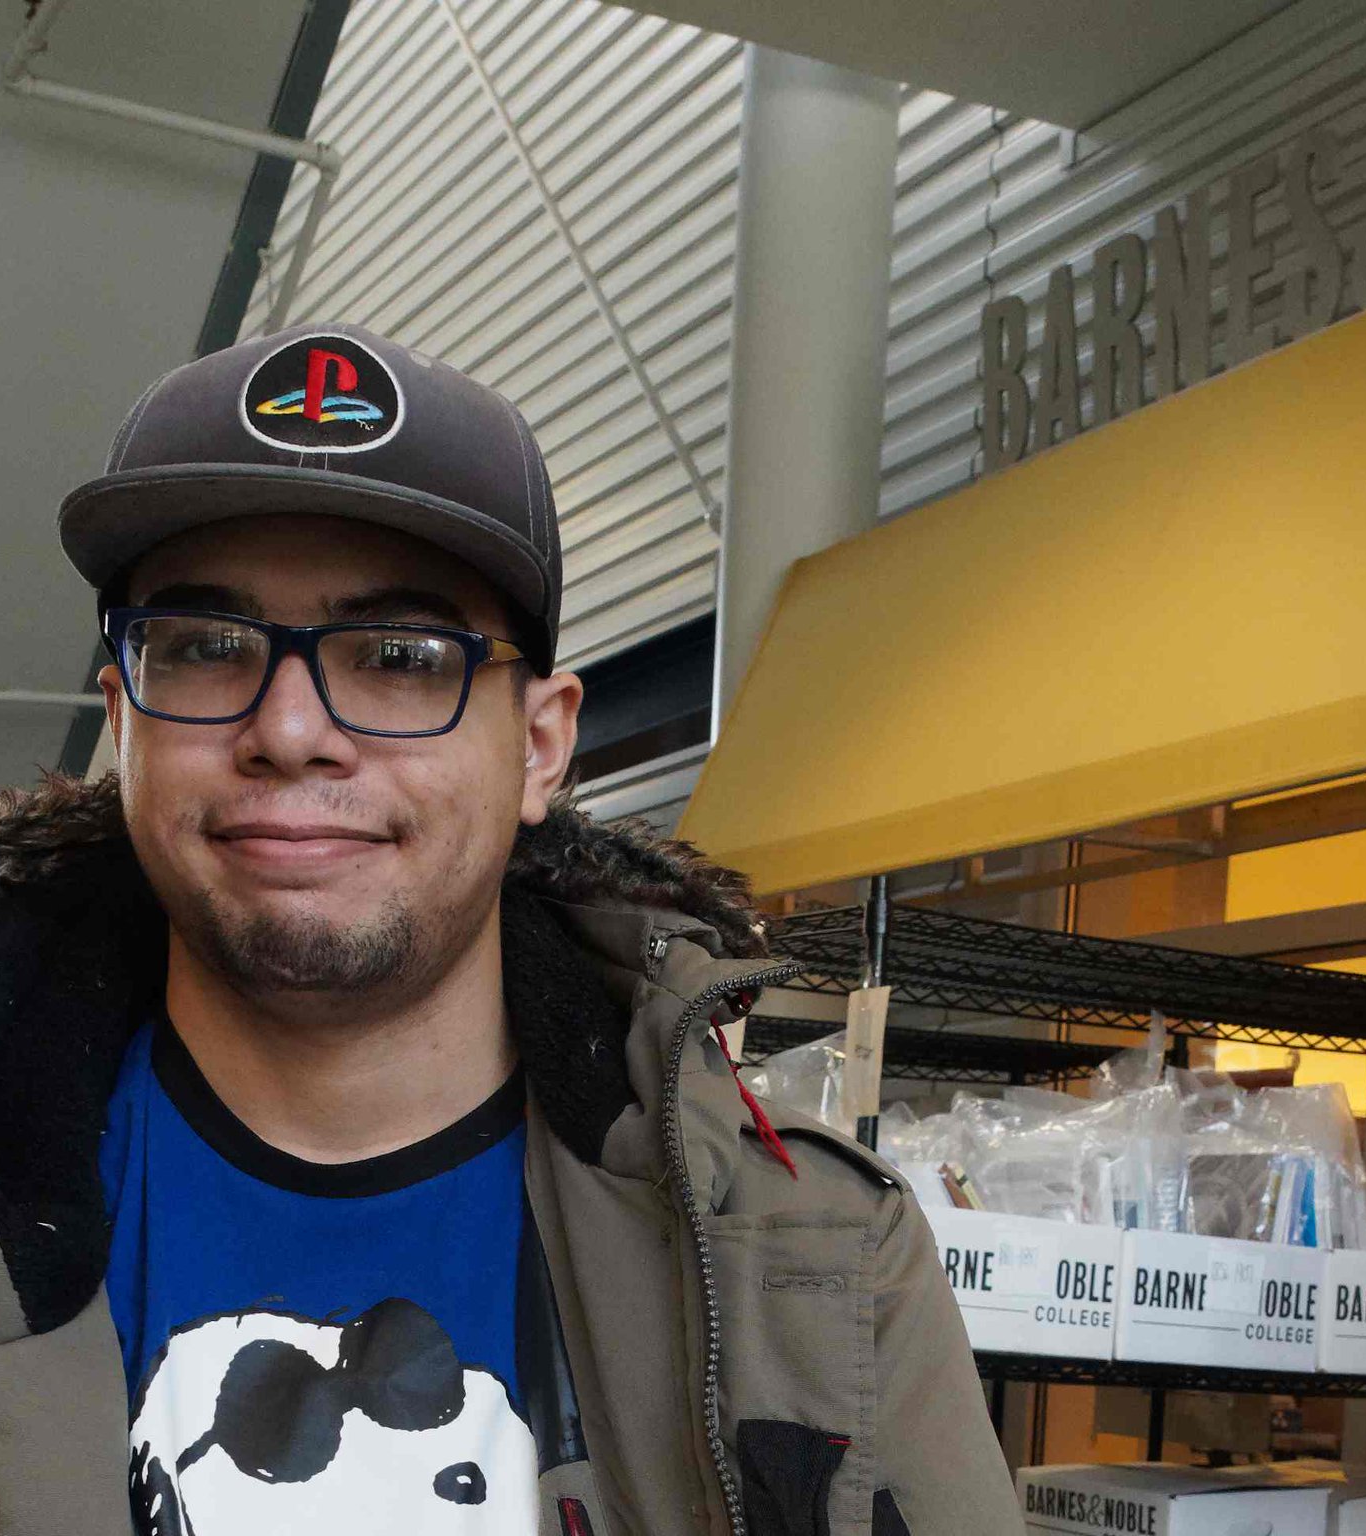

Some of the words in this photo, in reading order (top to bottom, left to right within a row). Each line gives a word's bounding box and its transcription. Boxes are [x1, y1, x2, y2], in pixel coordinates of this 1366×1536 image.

[982, 128, 1345, 474] BARNES
[1056, 1259, 1114, 1303] OBLE
[1133, 1267, 1207, 1311] BARNE
[1262, 1279, 1317, 1321] OBLE
[1034, 1305, 1111, 1328] COLLEGE
[1245, 1323, 1314, 1344] COLLEGE
[1026, 1483, 1085, 1523] BARNES
[1104, 1498, 1157, 1536] NOBLE
